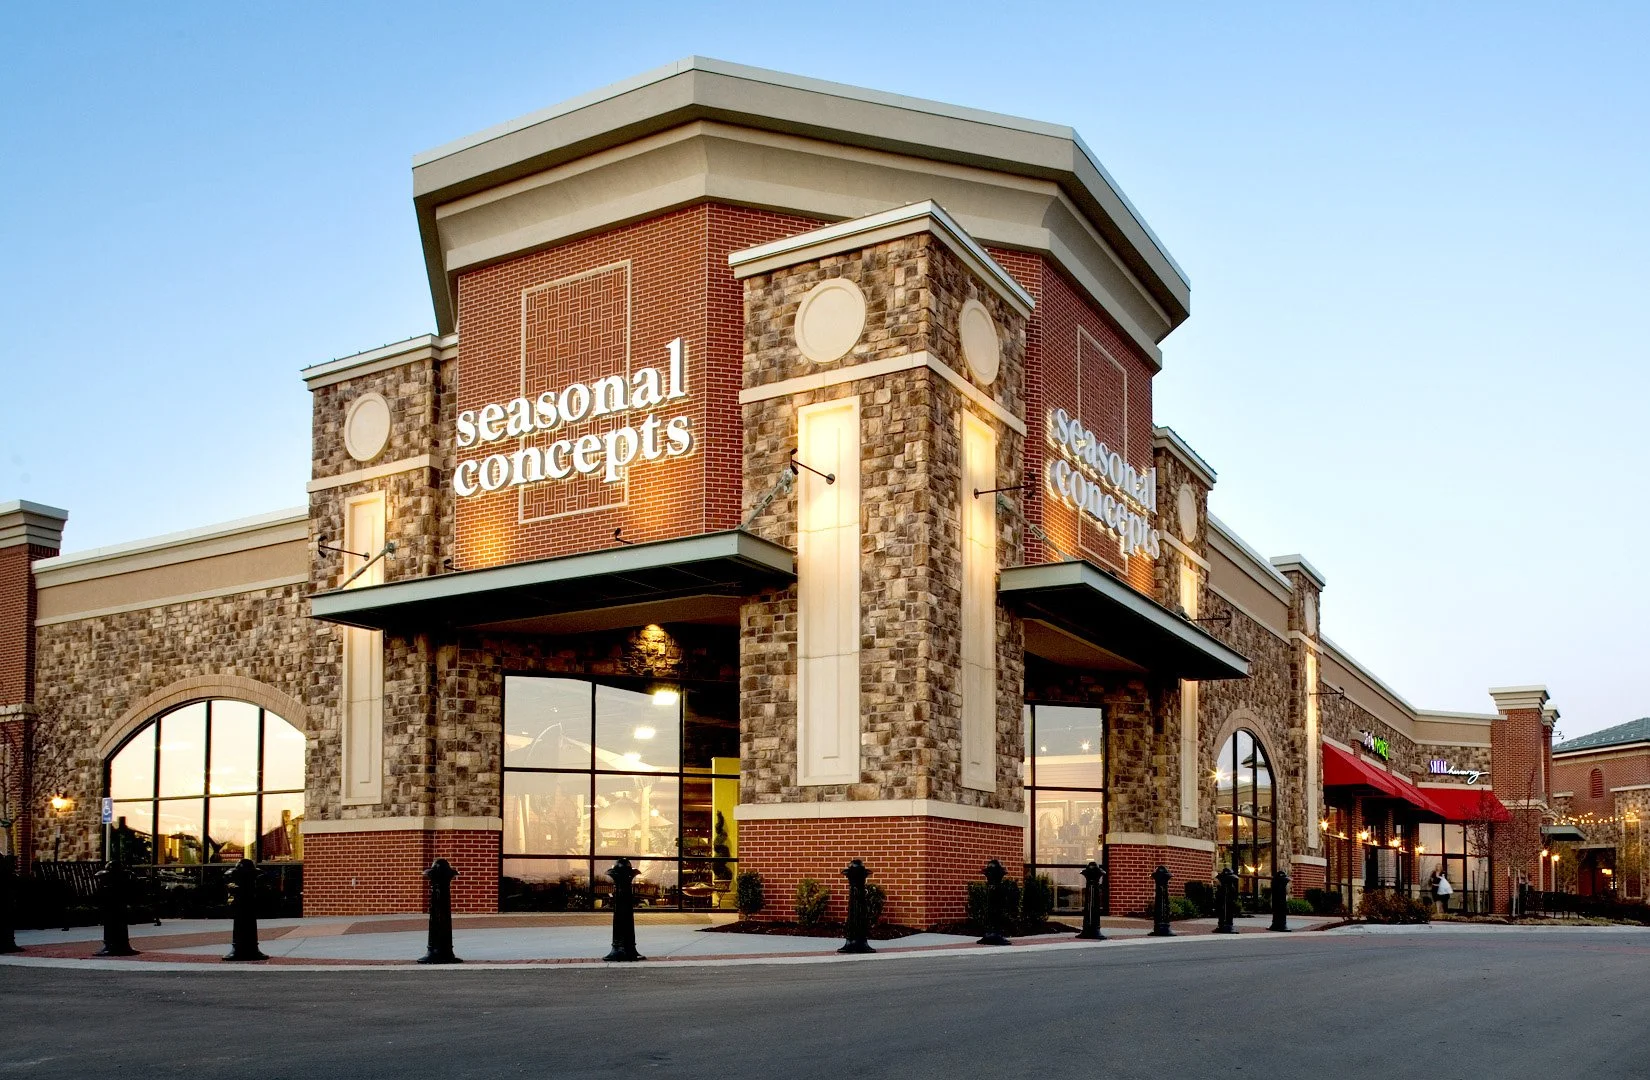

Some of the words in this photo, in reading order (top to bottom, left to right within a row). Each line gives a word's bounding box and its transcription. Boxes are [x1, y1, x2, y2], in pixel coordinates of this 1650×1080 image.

[457, 337, 689, 447] seasonal
[453, 413, 695, 497] concepts
[1051, 408, 1158, 515] seasonal
[1051, 459, 1160, 560] concepts
